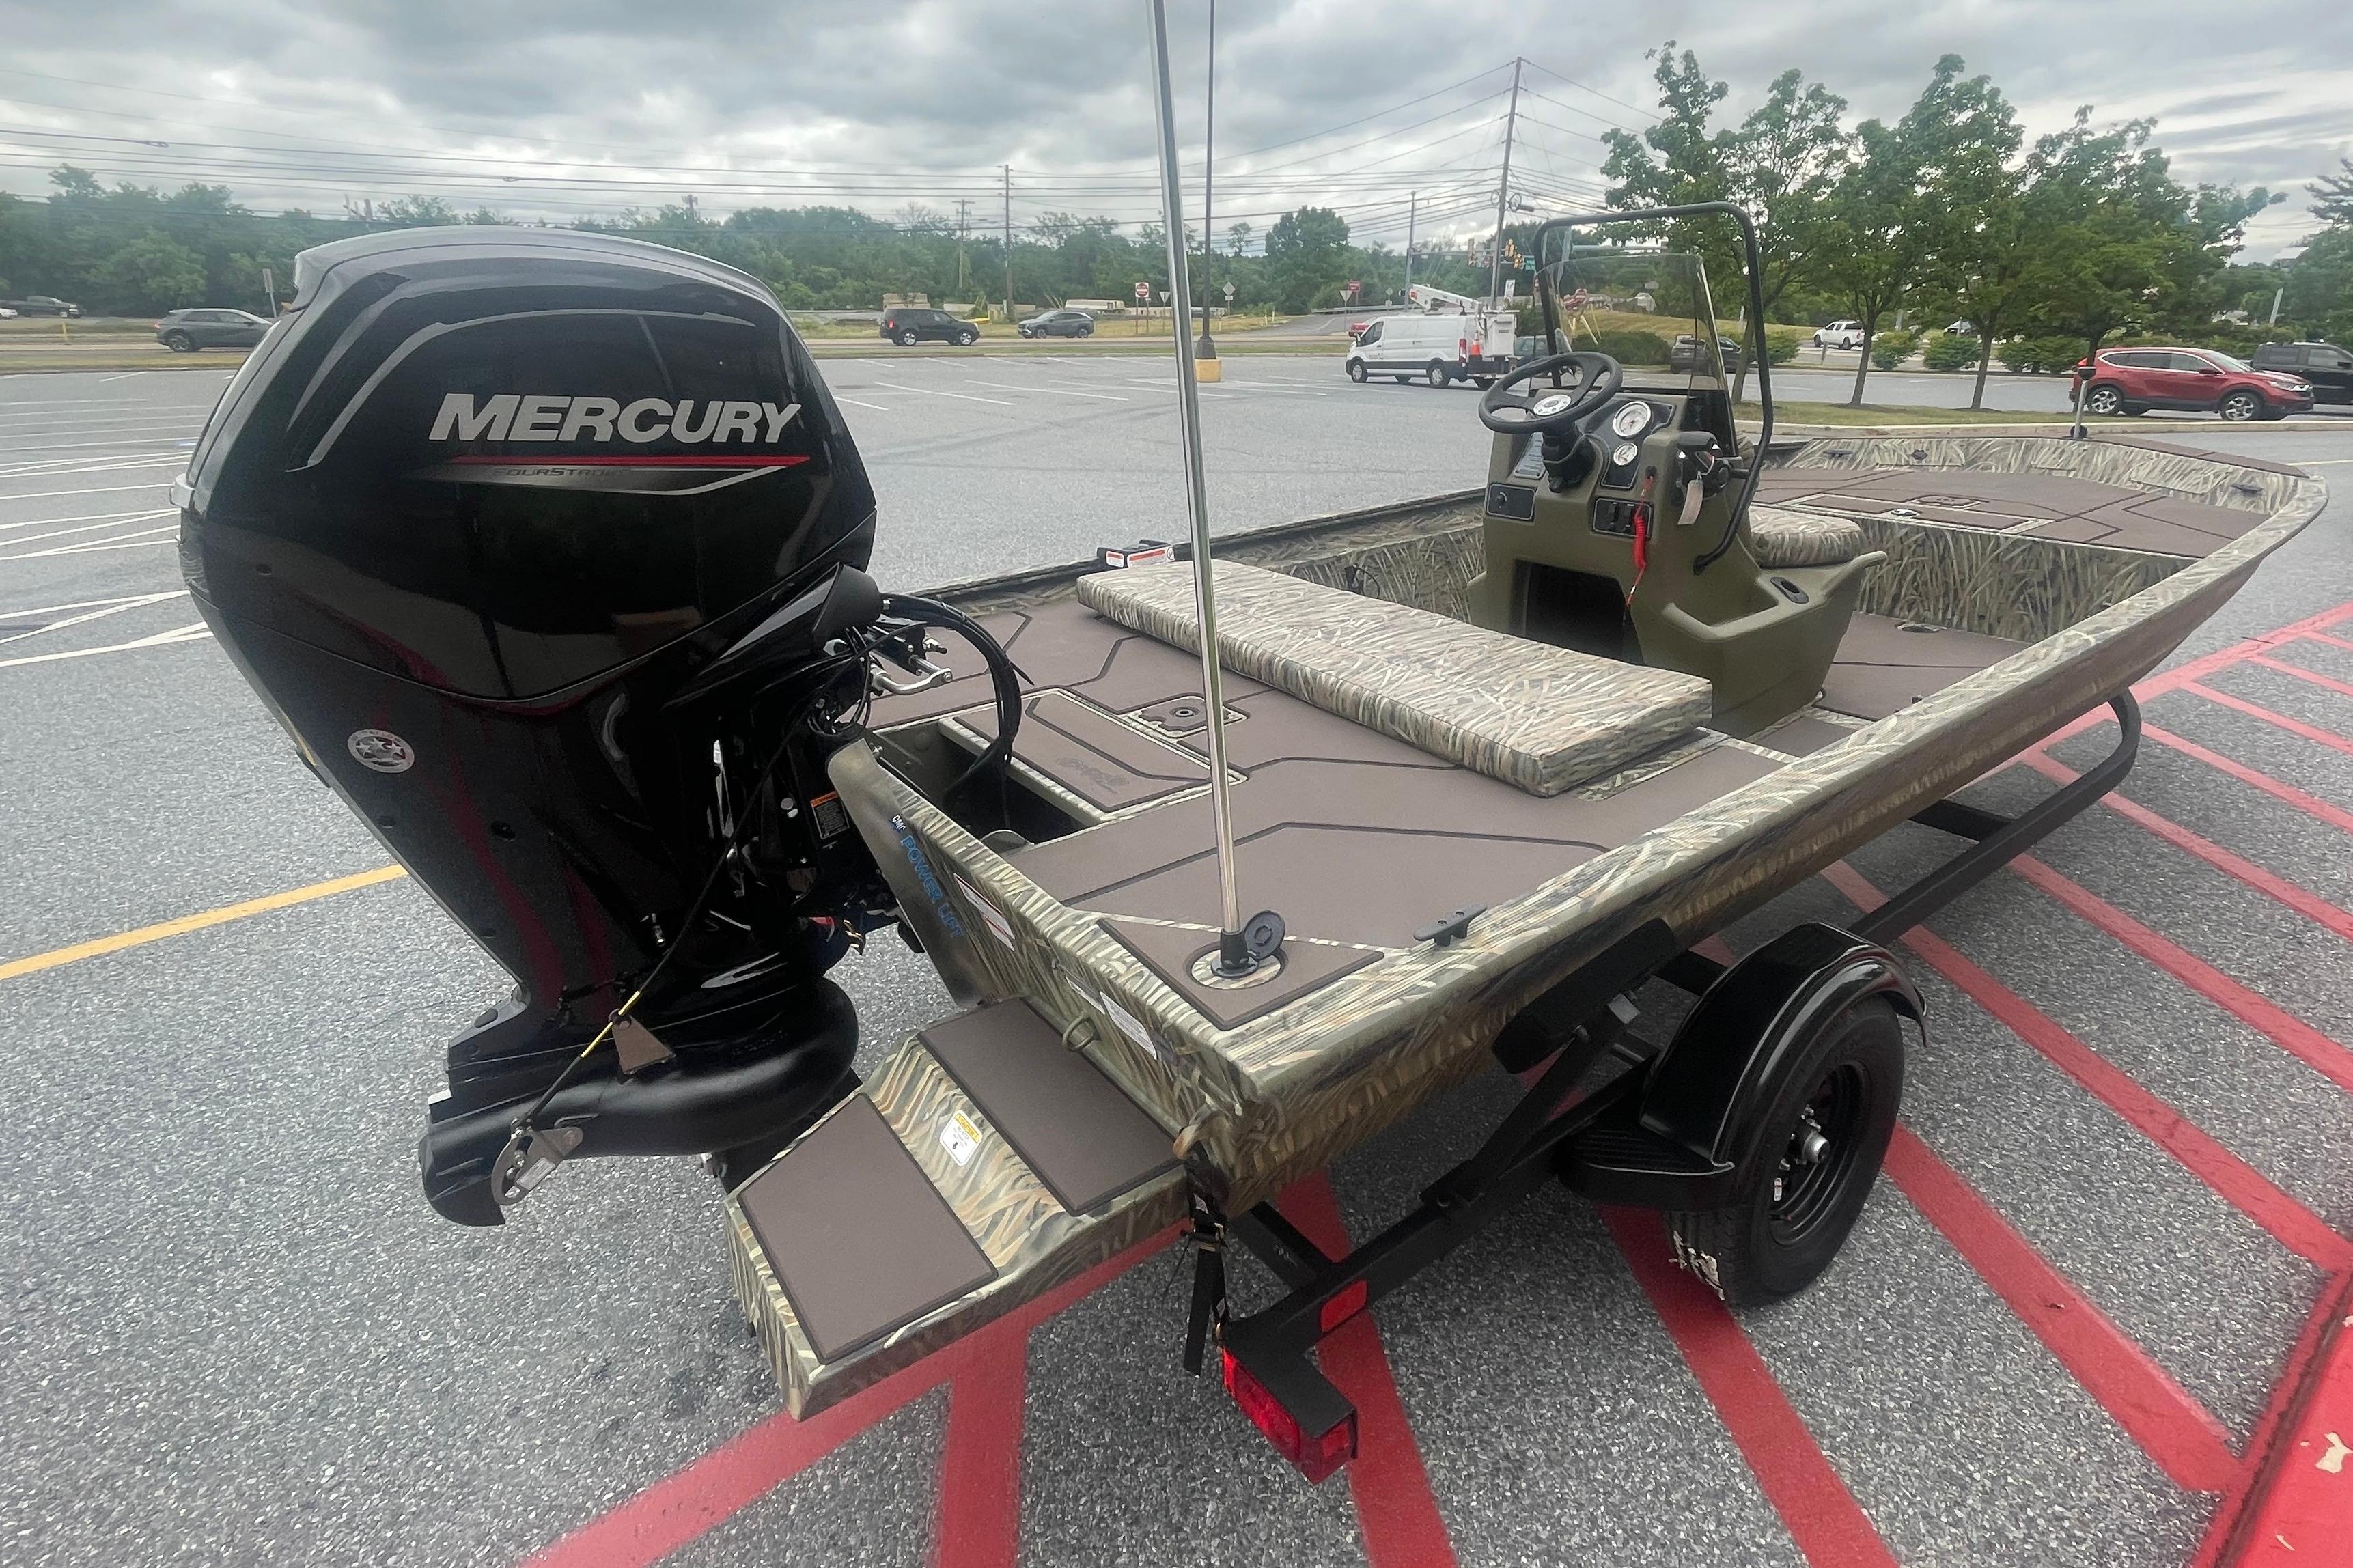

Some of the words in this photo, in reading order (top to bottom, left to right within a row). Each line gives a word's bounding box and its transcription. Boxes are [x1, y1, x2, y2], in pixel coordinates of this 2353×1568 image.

[428, 393, 803, 443] MERCURY
[891, 814, 907, 831] CMC
[900, 835, 943, 904] POWER
[938, 901, 966, 938] LIFT
